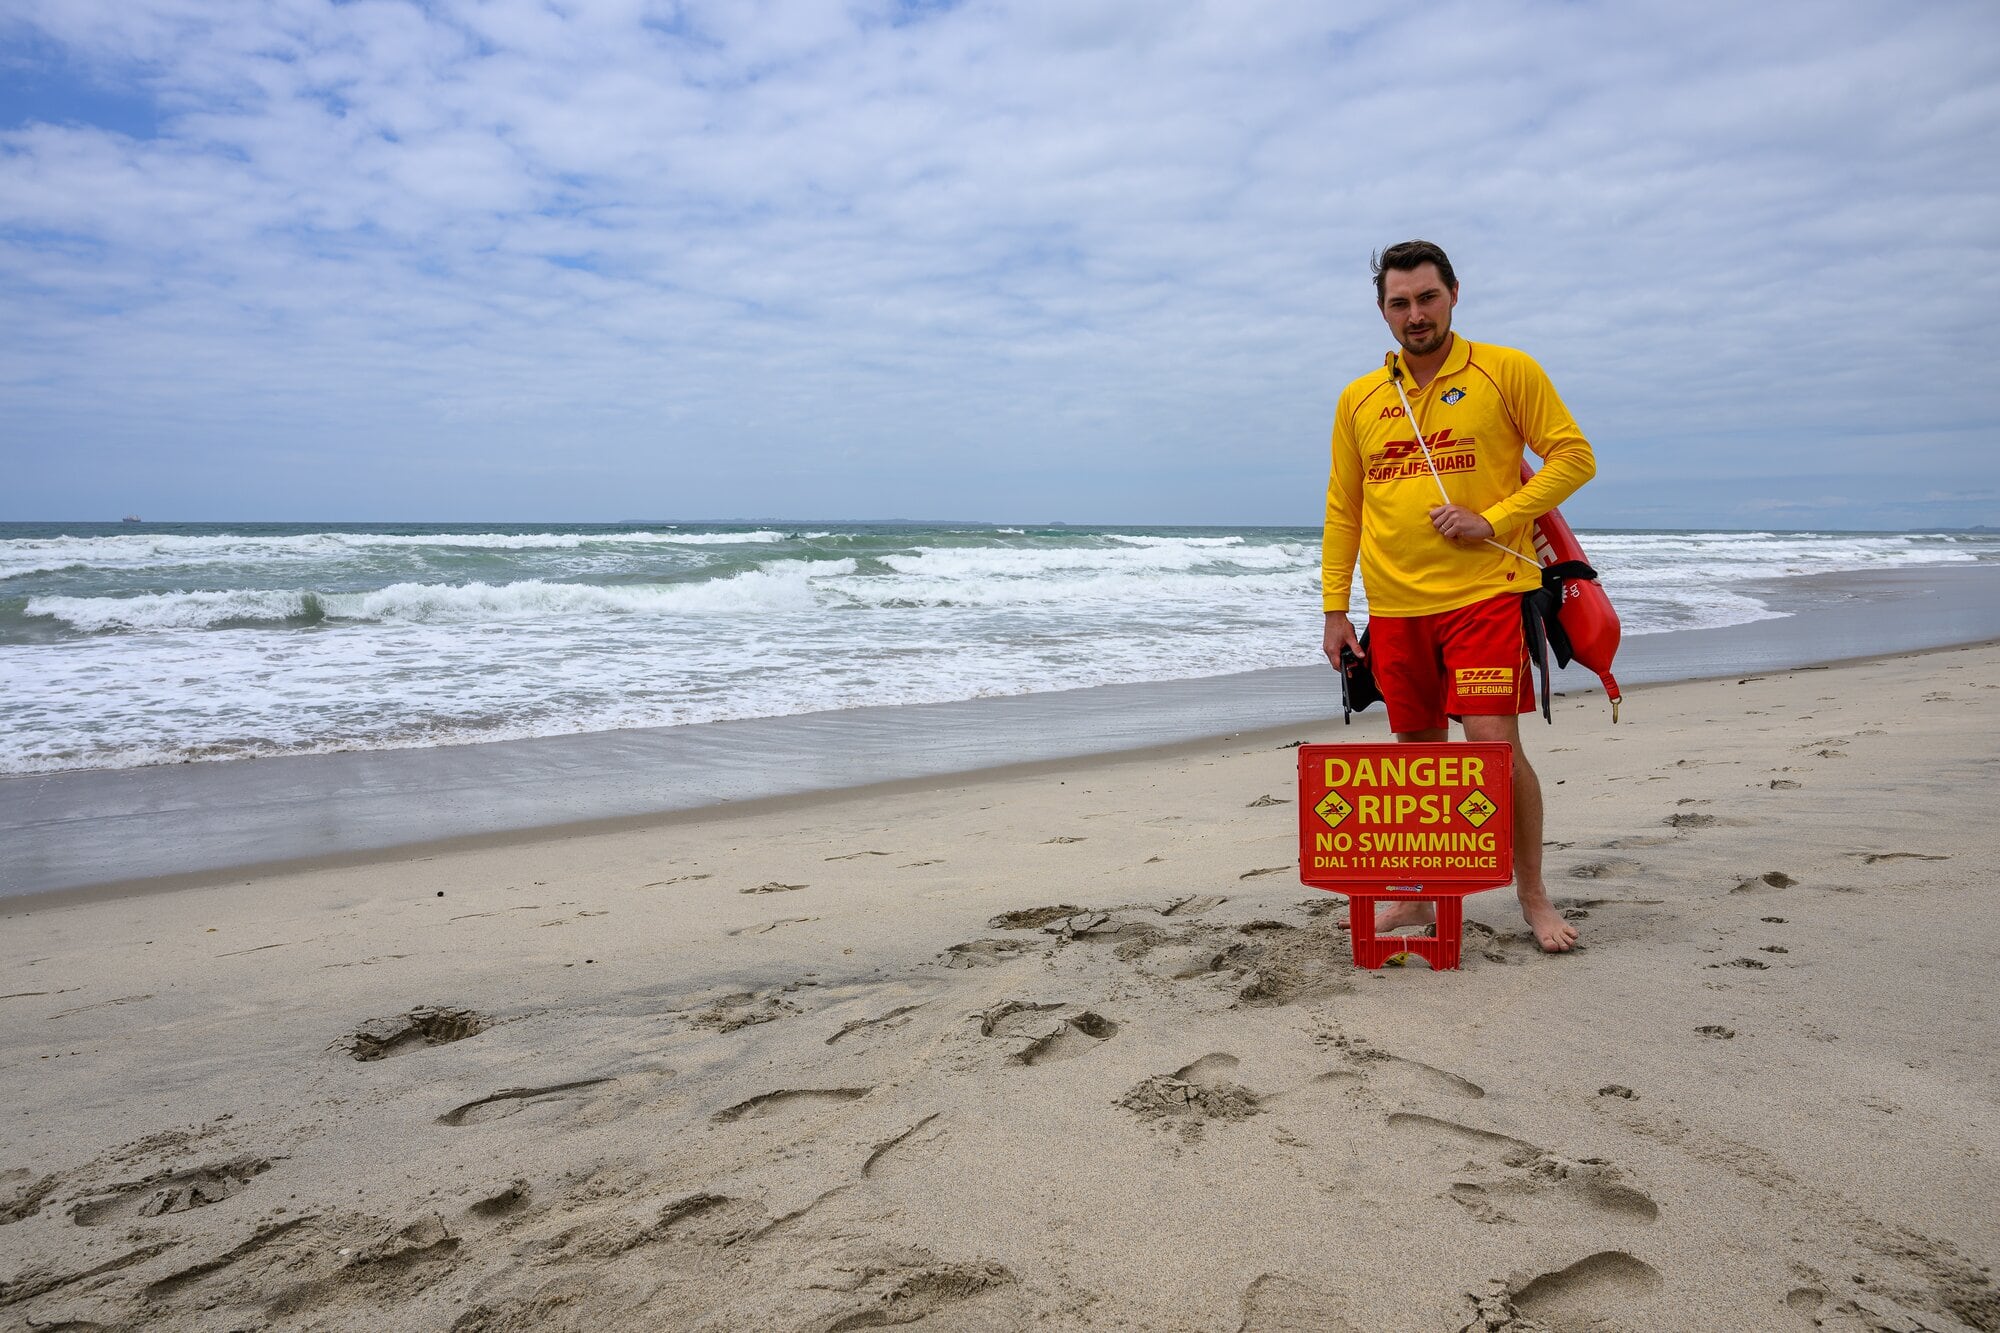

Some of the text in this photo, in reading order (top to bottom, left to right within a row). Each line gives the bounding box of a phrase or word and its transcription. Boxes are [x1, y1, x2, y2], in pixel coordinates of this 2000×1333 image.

[1382, 428, 1458, 459] DHL
[1570, 583, 1580, 597] bp
[1462, 670, 1504, 680] DHL
[1471, 686, 1513, 694] LIFEGUARD
[1324, 757, 1485, 787] DANGER
[1358, 794, 1452, 824] RIPS!
[1315, 832, 1496, 852] NO SWIMMING
[1314, 857, 1497, 869] DIAL 111 ASK FOR POLICE
